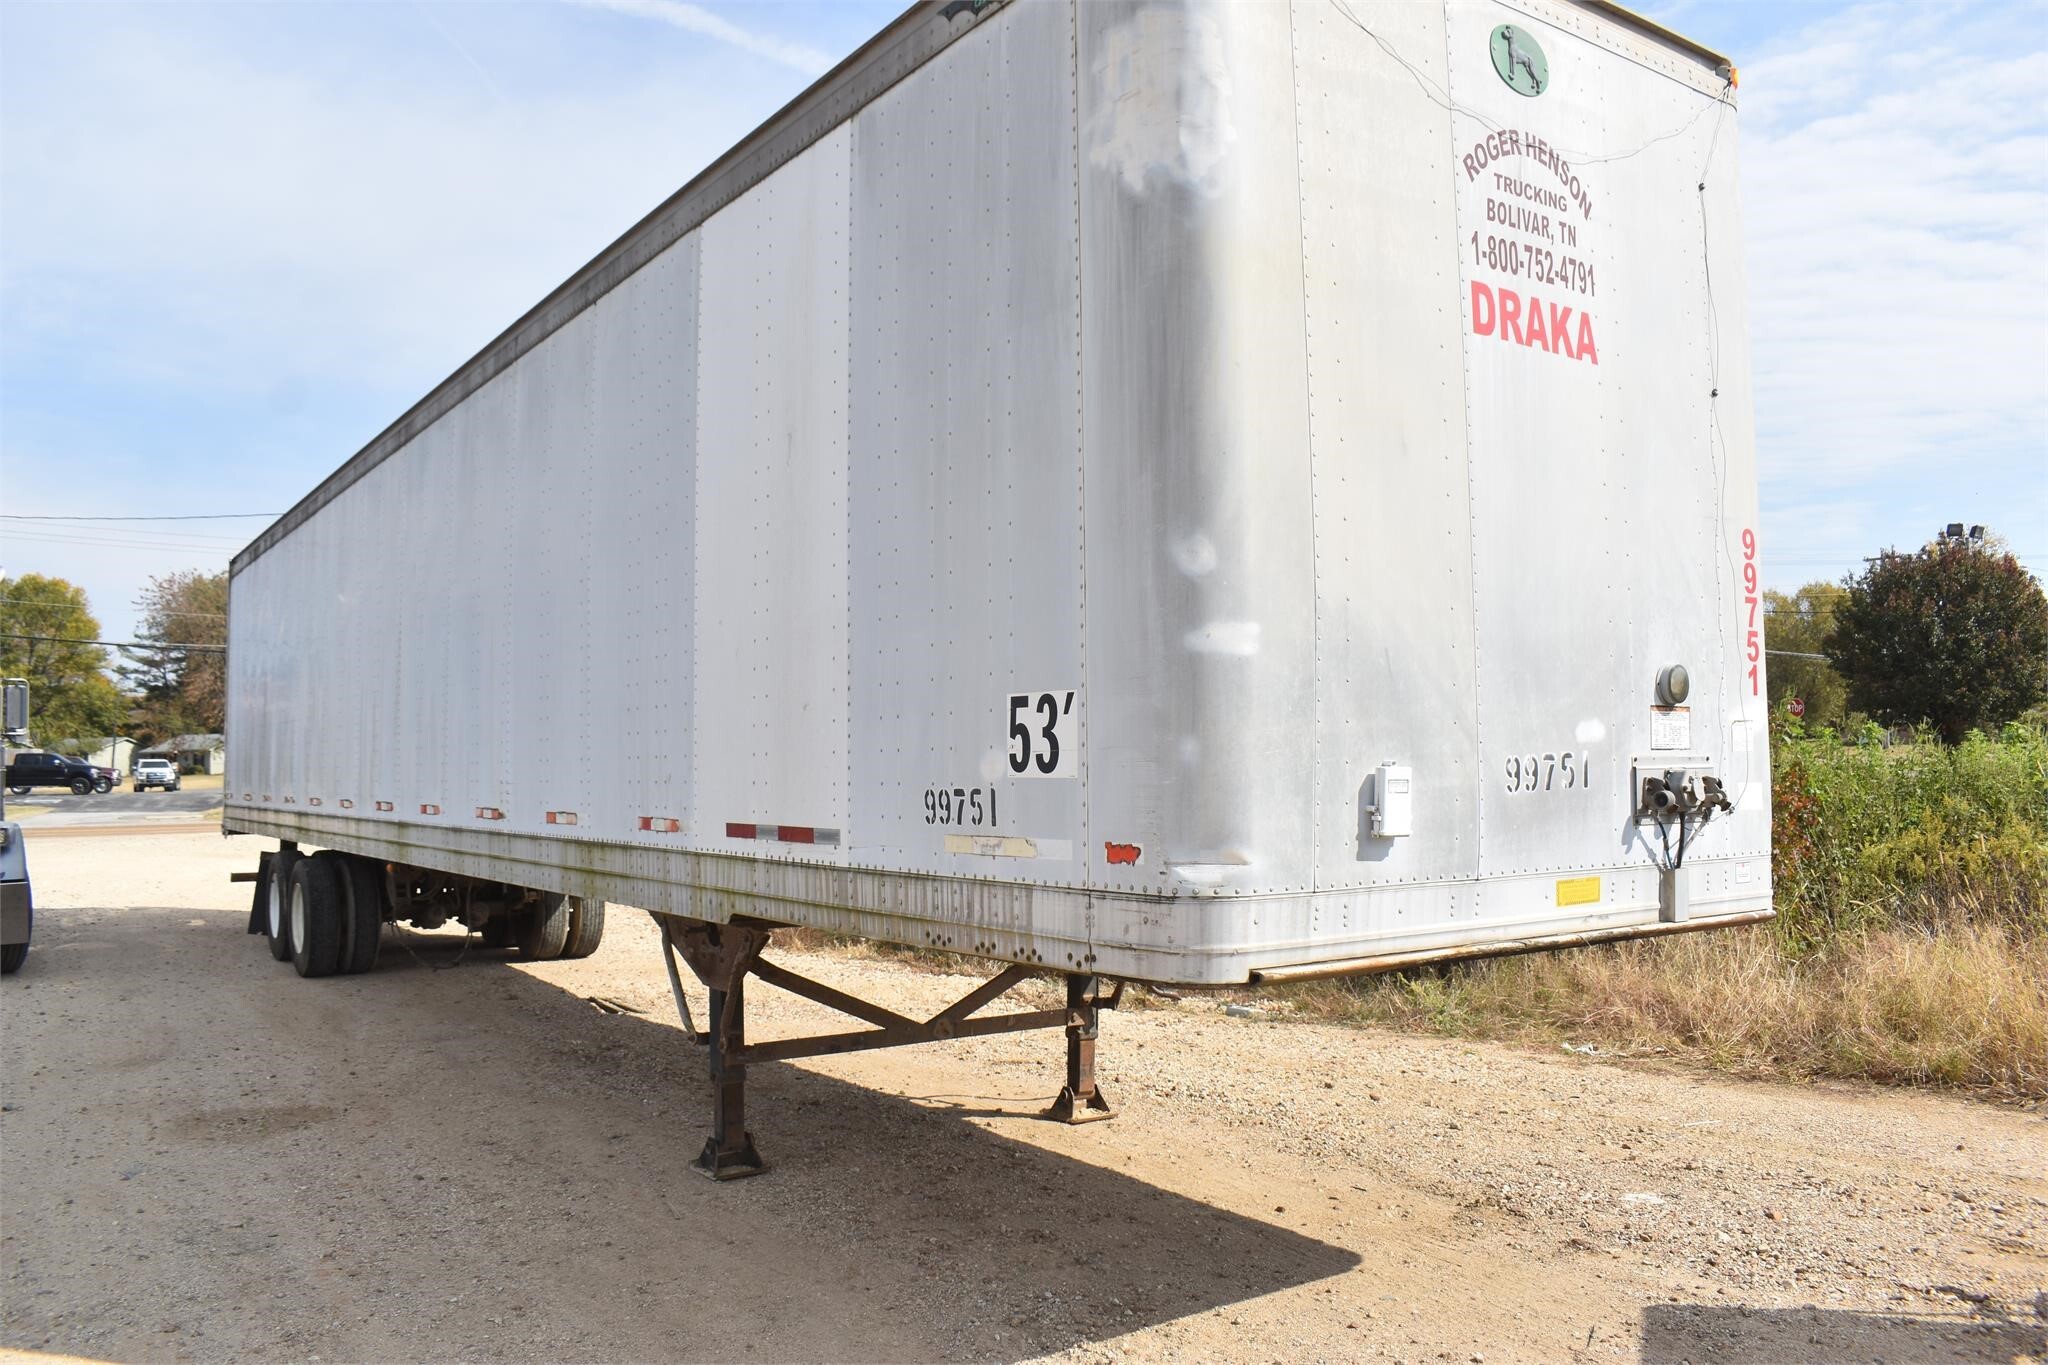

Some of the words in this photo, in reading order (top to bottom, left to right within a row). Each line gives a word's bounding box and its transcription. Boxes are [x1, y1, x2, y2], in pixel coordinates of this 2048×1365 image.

[1463, 129, 1522, 183] ROGER
[1525, 131, 1592, 220] HENSON
[1493, 172, 1567, 212] TRUCKING
[1487, 198, 1554, 245] BOLIVAR,
[1558, 221, 1577, 247] TN
[1471, 230, 1595, 297] 1-800-752-4791
[1471, 280, 1599, 365] DRAKA
[1742, 528, 1759, 696] 99751
[1008, 691, 1075, 774] 53'
[1505, 751, 1589, 793] 99751
[924, 787, 997, 828] 99751
